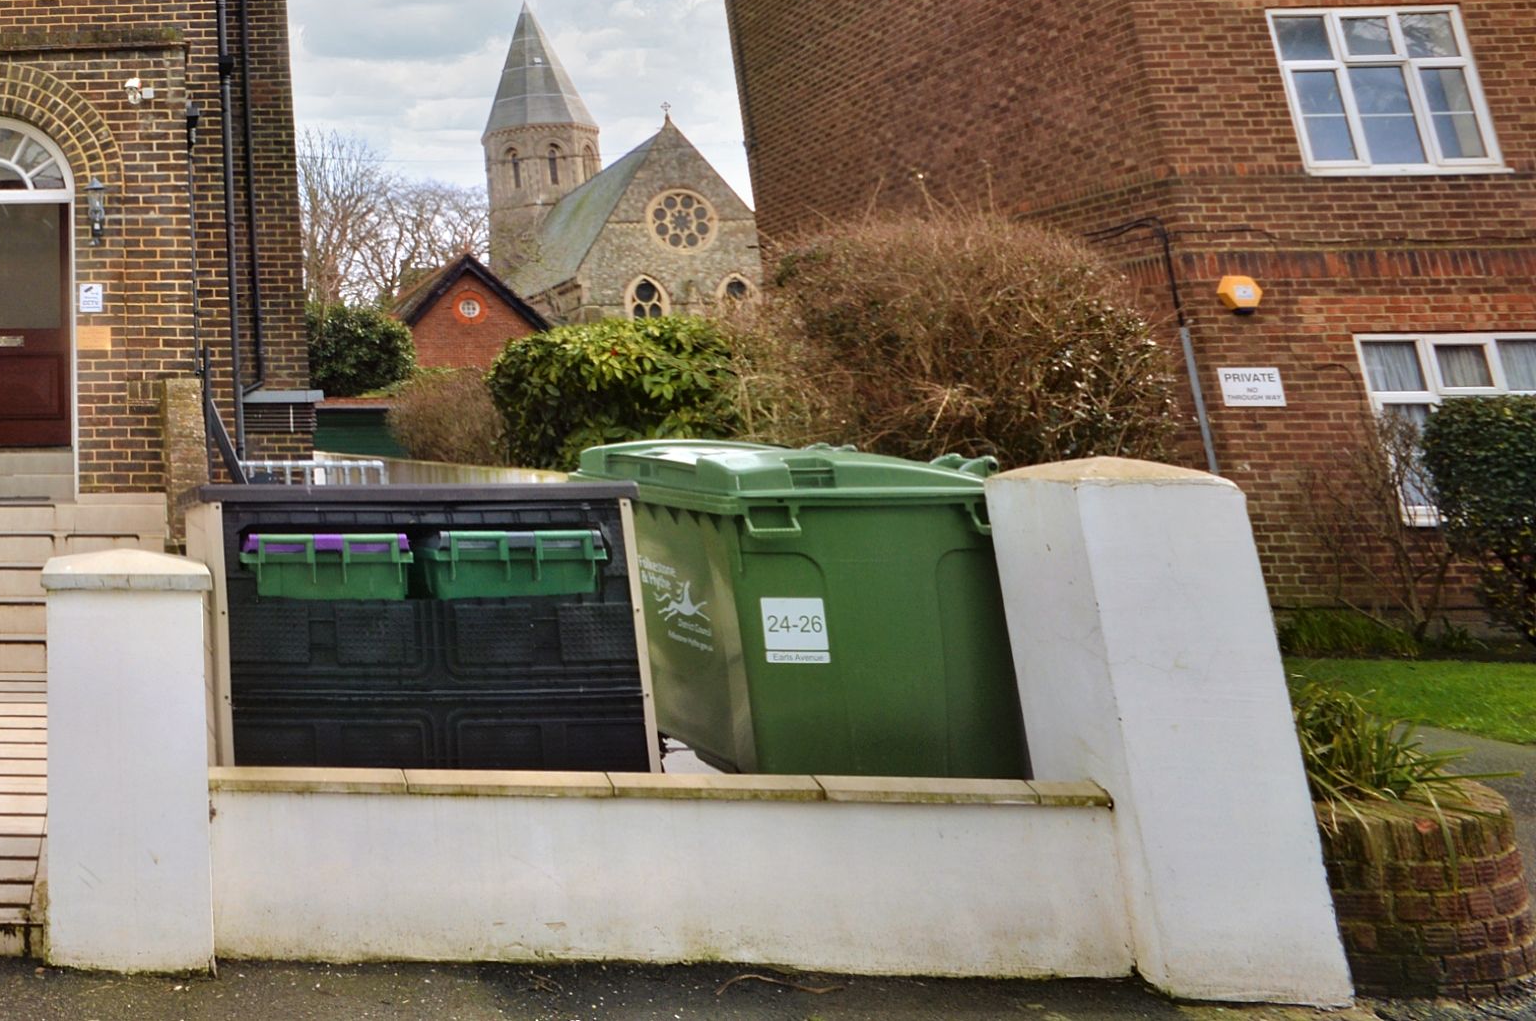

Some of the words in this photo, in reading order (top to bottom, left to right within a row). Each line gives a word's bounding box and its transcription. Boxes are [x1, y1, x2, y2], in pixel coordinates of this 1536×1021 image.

[1224, 373, 1276, 382] PRIVATE
[638, 555, 677, 577] Folkestone
[767, 615, 823, 633] 24-26
[773, 653, 793, 661] Earls
[795, 653, 824, 661] Avenue
